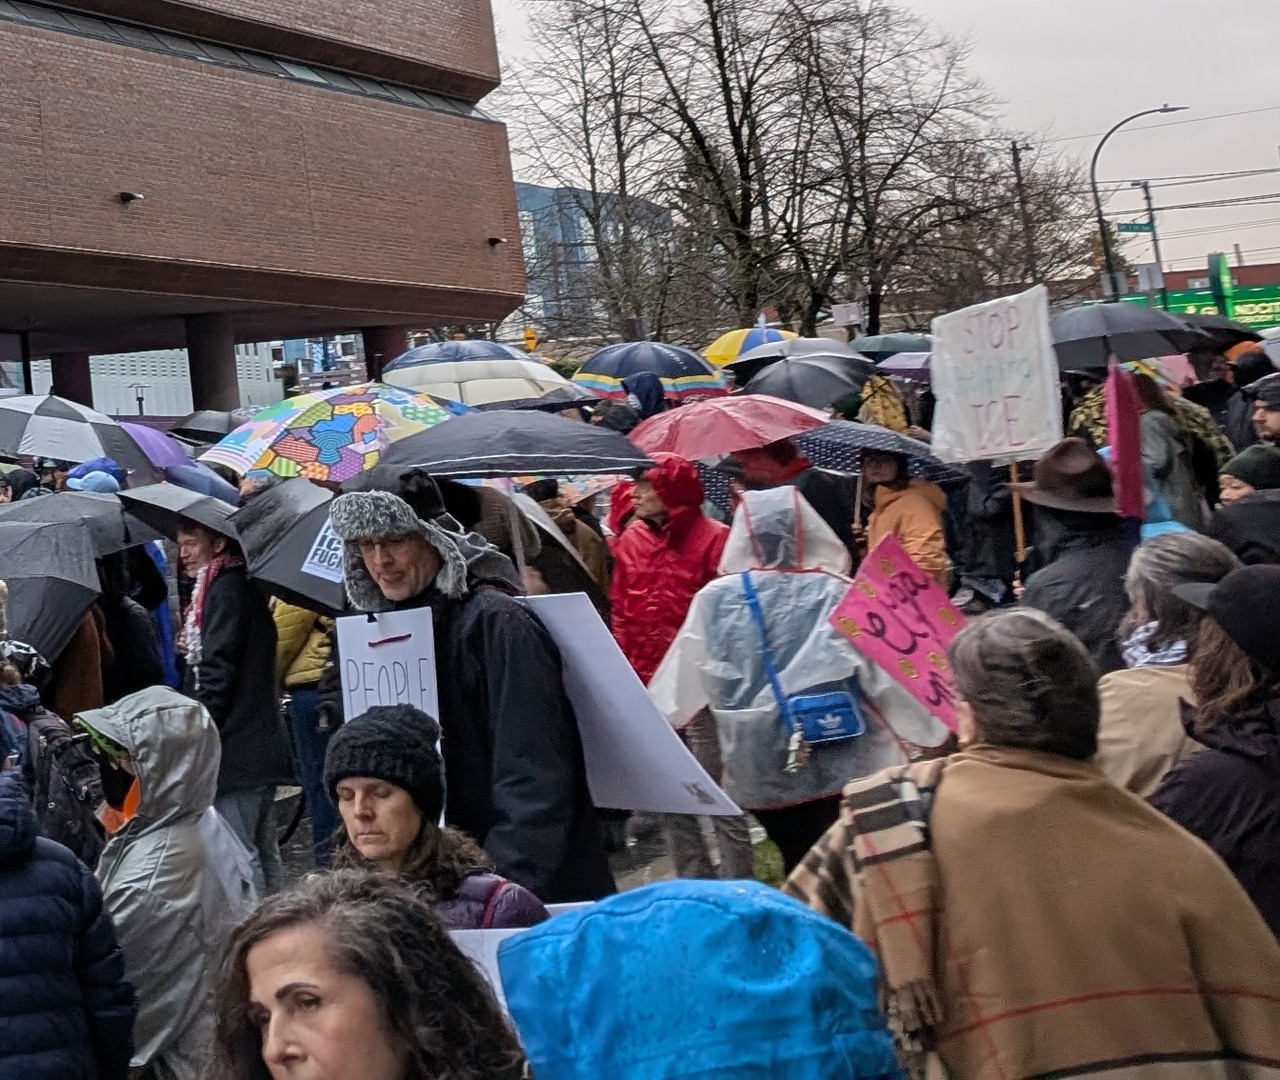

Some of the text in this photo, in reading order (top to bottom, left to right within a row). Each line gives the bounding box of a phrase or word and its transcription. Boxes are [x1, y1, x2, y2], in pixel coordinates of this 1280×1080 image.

[970, 394, 1025, 451] ICE
[317, 534, 343, 552] IC
[346, 657, 429, 718] PEOPLE
